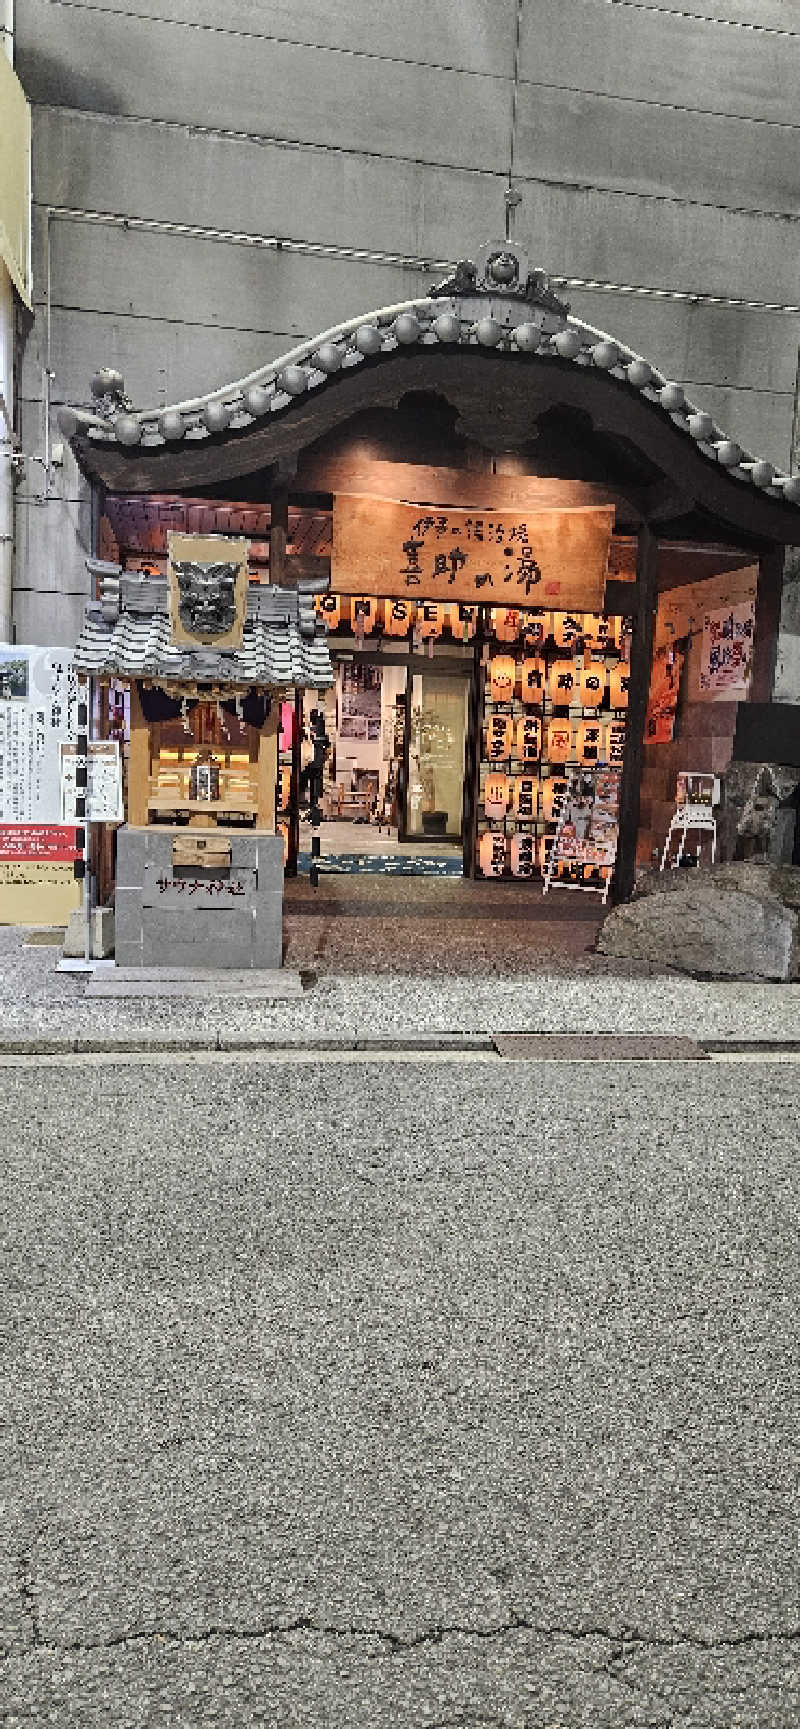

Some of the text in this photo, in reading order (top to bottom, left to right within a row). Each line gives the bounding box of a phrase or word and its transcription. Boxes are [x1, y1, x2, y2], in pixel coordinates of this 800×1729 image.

[400, 536, 542, 595] 喜助の湯
[156, 878, 245, 896] サウナ神社
